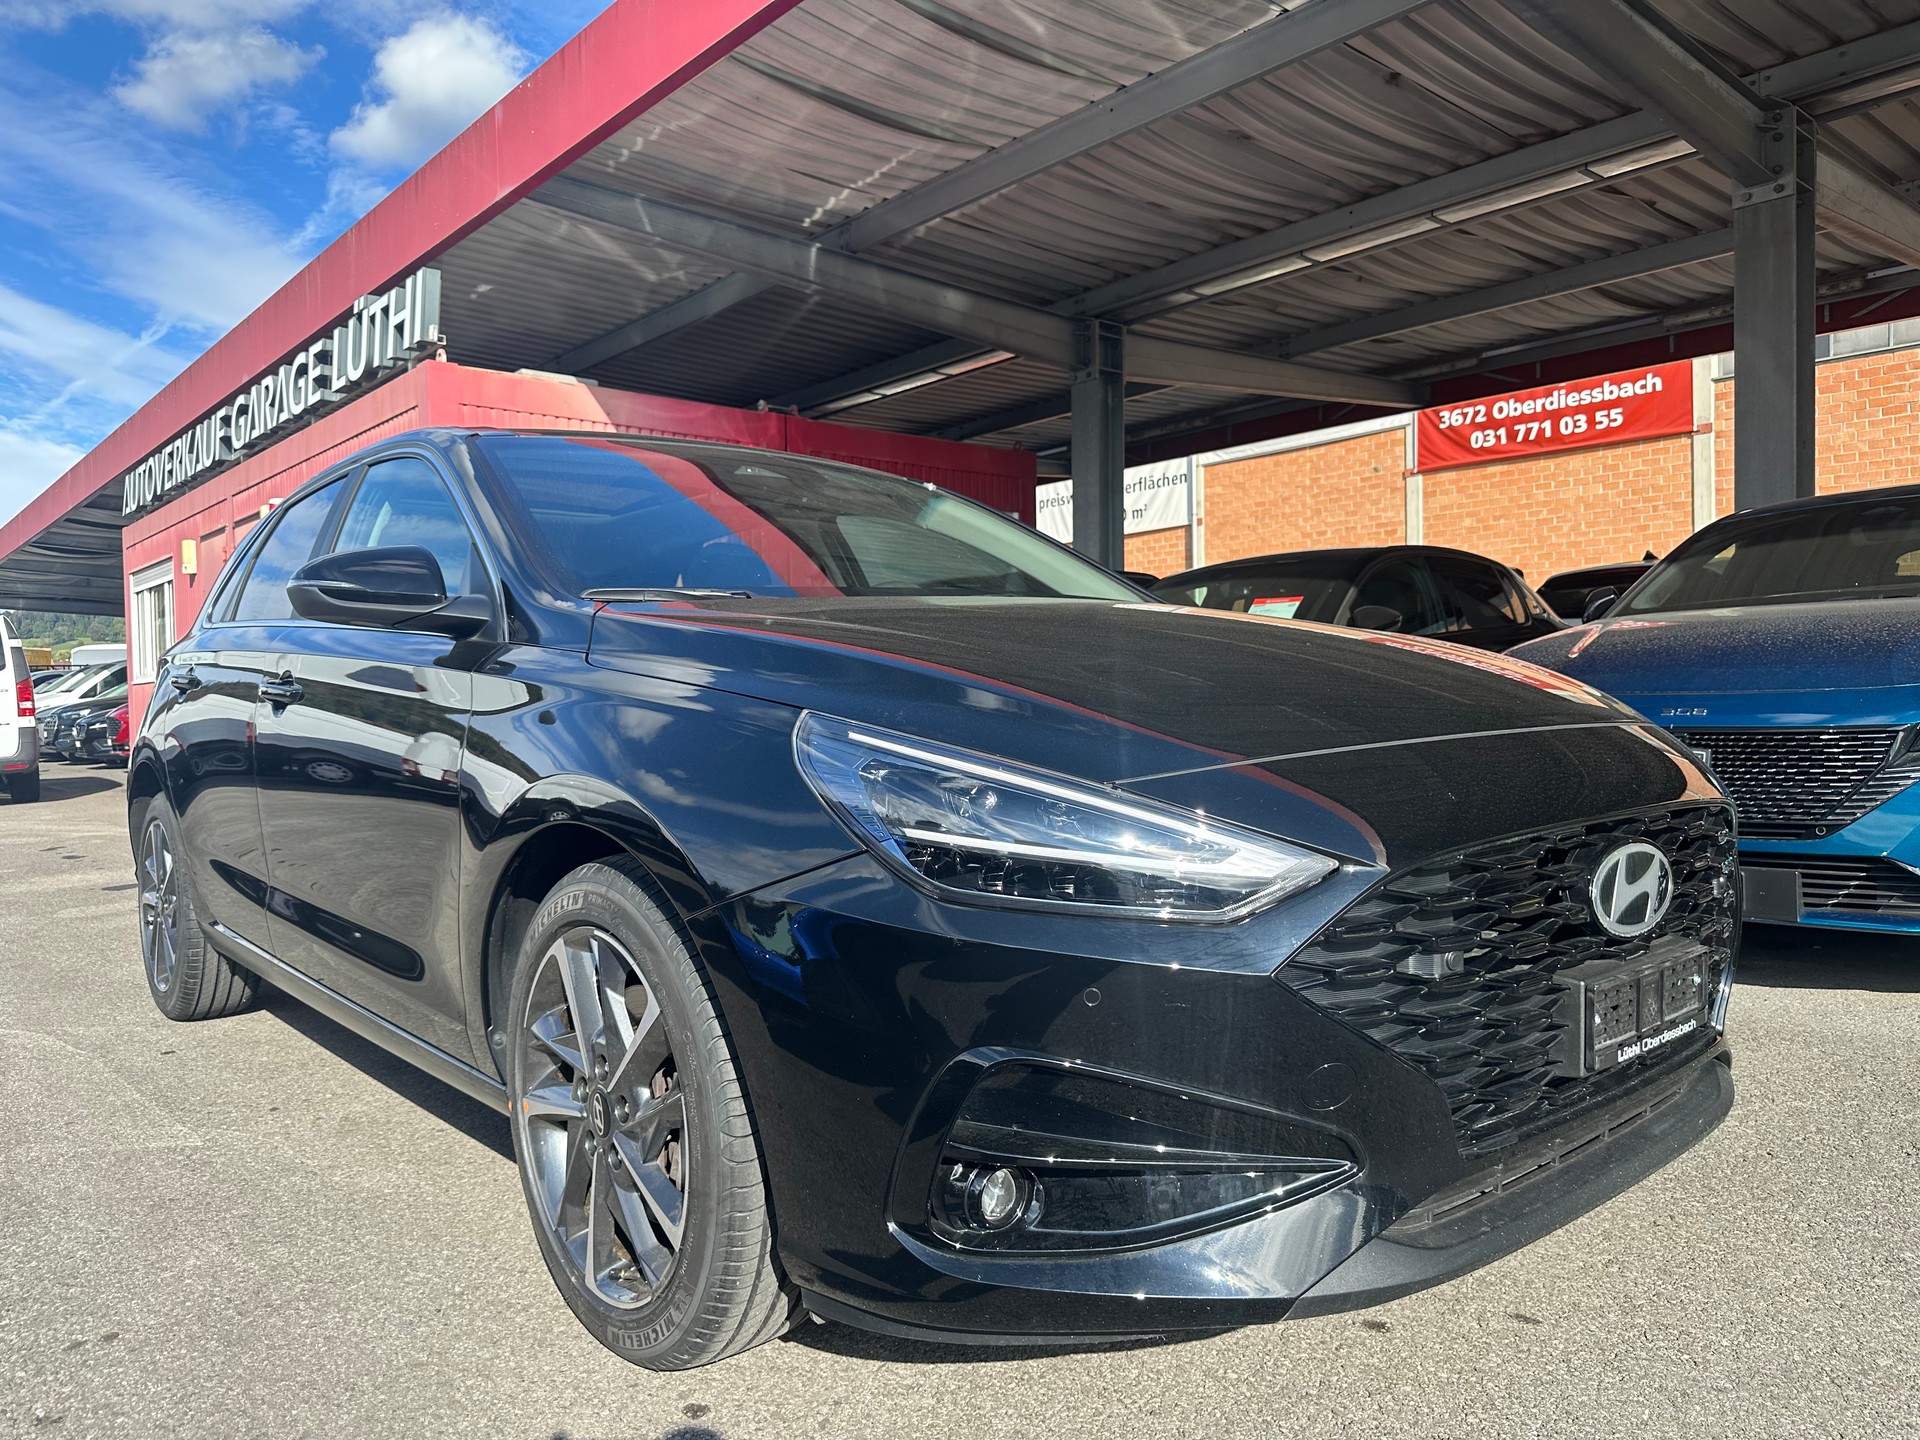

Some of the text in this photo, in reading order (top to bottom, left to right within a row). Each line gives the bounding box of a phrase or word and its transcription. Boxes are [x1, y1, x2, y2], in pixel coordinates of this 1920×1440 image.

[122, 267, 436, 517] AUTOVERKAUF GARAGE LÜTHI
[1439, 373, 1663, 429] 3672 Oberdiessbach
[1470, 407, 1624, 450] 031 771 03 55
[1039, 472, 1188, 513] preis erflächen
[526, 891, 584, 950] MICHELIN
[1642, 1018, 1697, 1051] Oberdiessbach
[611, 1311, 676, 1348] MICHELIN
